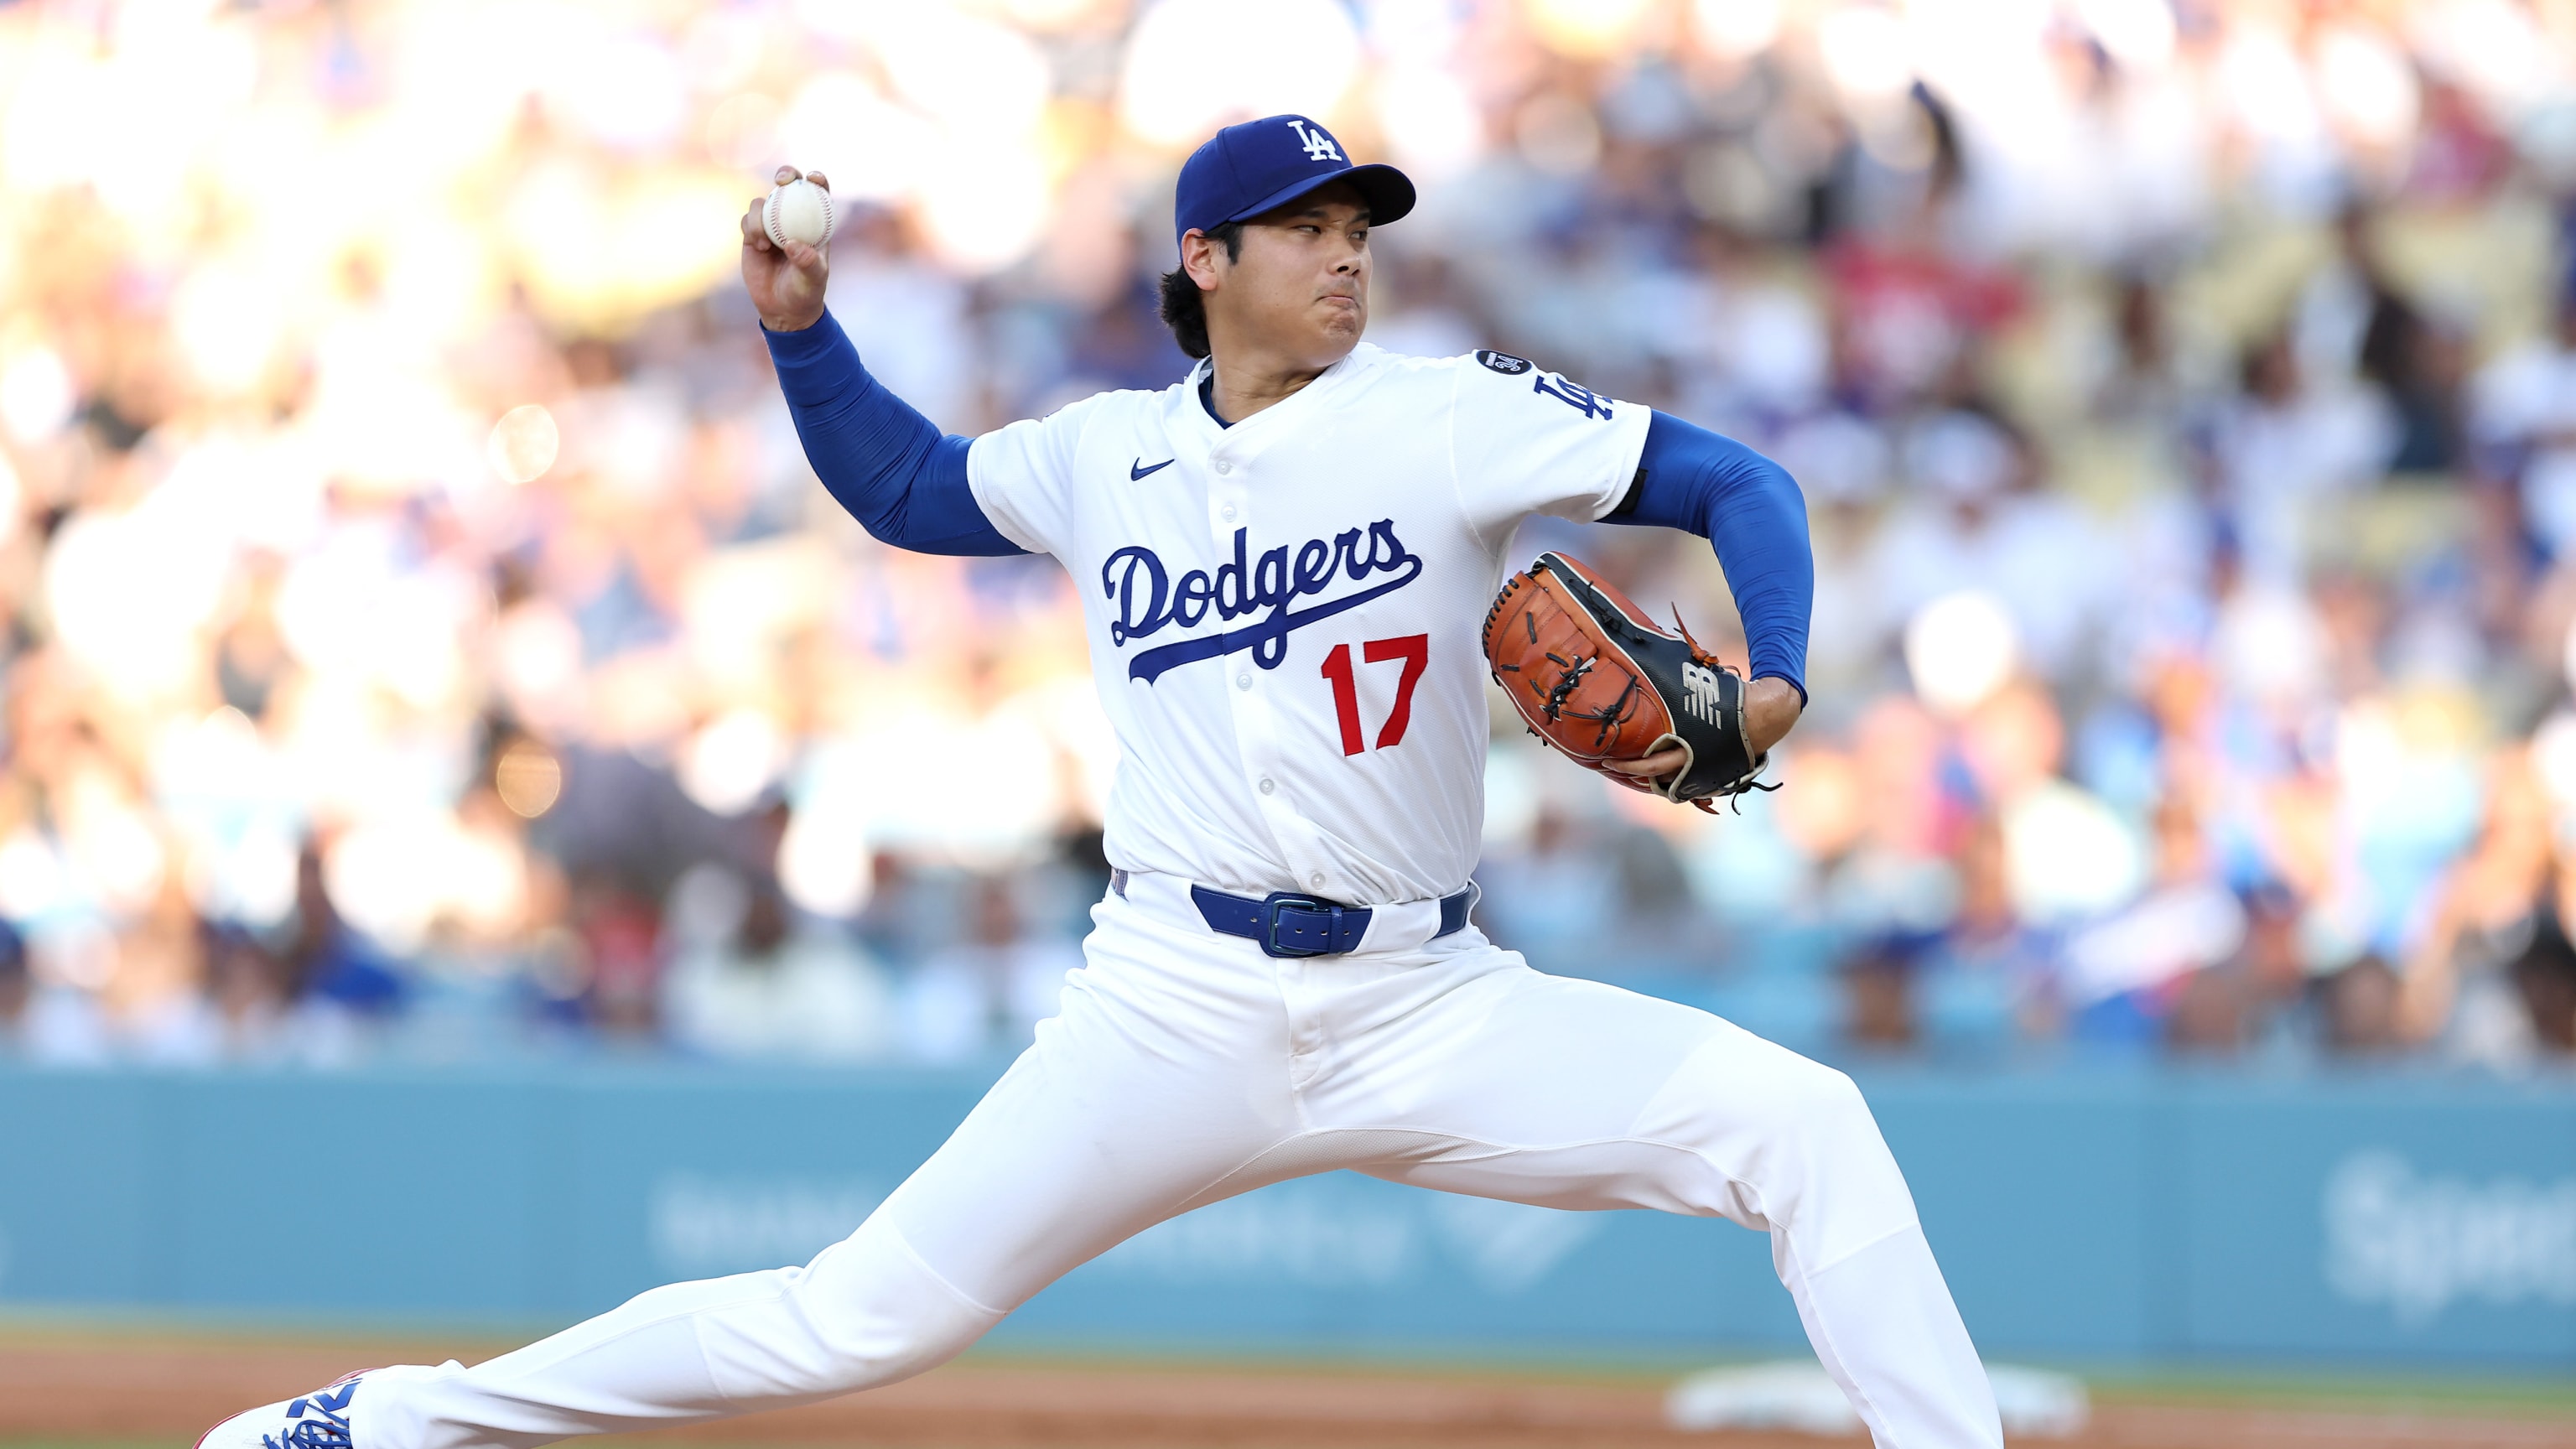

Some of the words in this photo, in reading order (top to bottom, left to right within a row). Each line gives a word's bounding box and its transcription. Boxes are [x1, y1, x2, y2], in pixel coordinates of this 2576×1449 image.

[1287, 120, 1343, 161] LA
[1534, 375, 1613, 421] LA
[1102, 517, 1423, 687] Dodgers
[1321, 633, 1429, 757] 17
